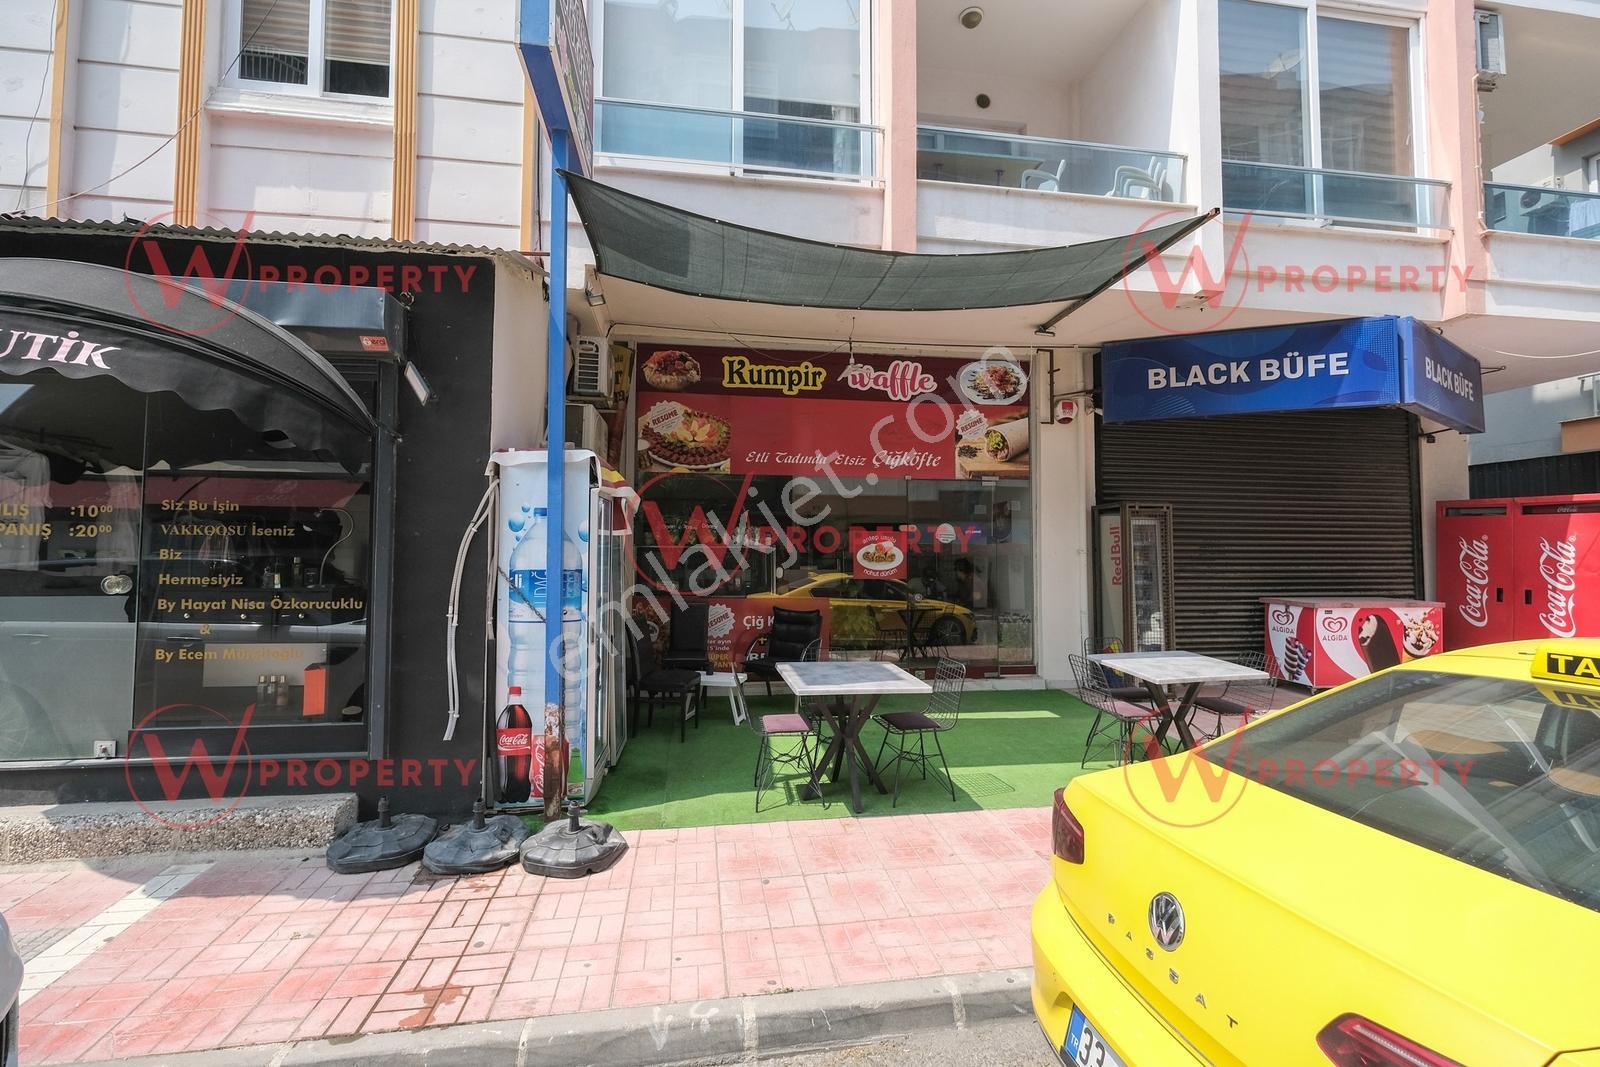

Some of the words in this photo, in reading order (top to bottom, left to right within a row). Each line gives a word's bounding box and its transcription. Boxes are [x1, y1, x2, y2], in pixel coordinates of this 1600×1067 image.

[725, 358, 824, 393] Kumpir
[1148, 366, 1250, 389] BLACK
[1260, 352, 1349, 382] BÜFE
[849, 362, 937, 399] waffle
[1425, 356, 1453, 391] BLACK
[1453, 371, 1474, 402] BÜFE
[746, 451, 770, 463] Etli
[834, 453, 867, 466] Etsiz
[872, 450, 941, 469] Çiğköfte
[161, 500, 184, 511] Siz
[189, 500, 208, 511] Bu
[213, 497, 240, 514] İşin
[252, 522, 296, 537] İseniz
[159, 548, 182, 560] Biz
[158, 573, 244, 588] Hermesiyiz
[157, 598, 176, 612] By
[181, 598, 227, 612] Hayat
[232, 598, 265, 610] Nisa
[270, 595, 363, 610] Özkorucuklu
[199, 624, 213, 635] &
[743, 615, 764, 630] Çiğ
[155, 648, 174, 662] By
[179, 648, 218, 660] Ecem
[1071, 1034, 1080, 1048] TR
